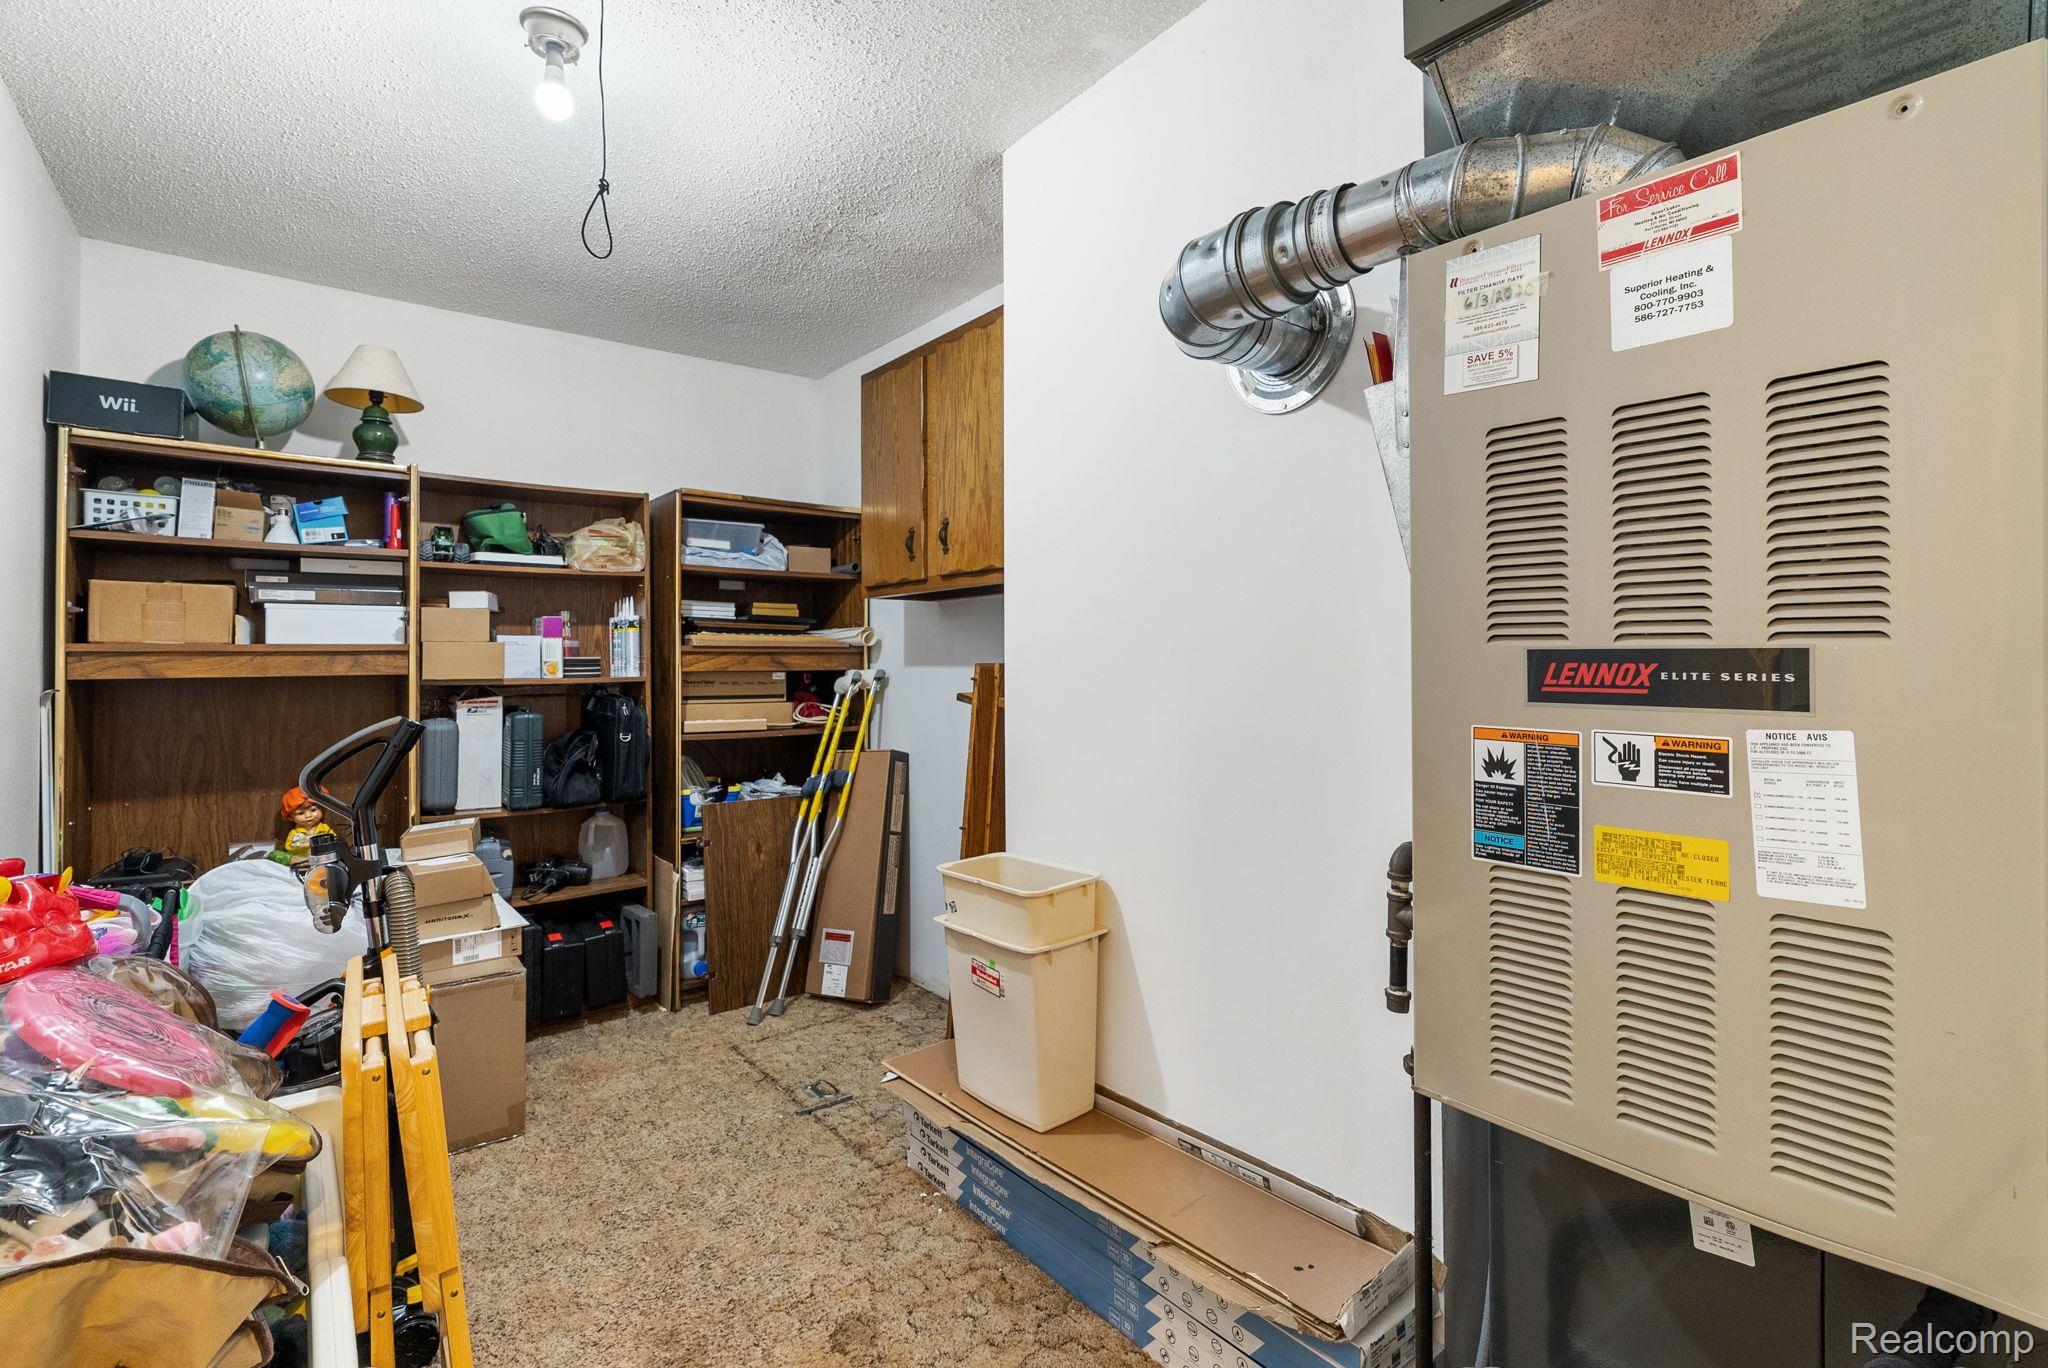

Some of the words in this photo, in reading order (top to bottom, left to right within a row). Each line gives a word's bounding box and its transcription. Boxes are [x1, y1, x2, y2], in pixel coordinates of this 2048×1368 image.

[1601, 196, 1630, 218] For
[1635, 185, 1685, 208] Service
[1690, 162, 1728, 190] Call
[1644, 228, 1692, 249] LENNOX
[1458, 288, 1477, 296] FILTER
[1480, 281, 1505, 290] CHANGE
[1624, 279, 1663, 294] Superior
[1665, 268, 1703, 283] Heating
[1680, 281, 1697, 290] Inc.
[1634, 289, 1704, 312] 800-770-9903
[1634, 300, 1704, 323] 586-727-7753
[1467, 351, 1494, 364] SAVE
[1499, 348, 1513, 358] 5%
[99, 395, 136, 412] Wii
[1544, 662, 1660, 686] LENNOX
[1660, 672, 1711, 681] ELITE
[1720, 672, 1796, 683] SERIES
[1671, 740, 1721, 750] WARNING
[1484, 835, 1514, 845] NOTICE
[1694, 852, 1719, 862] CLOSED
[1706, 878, 1728, 887] FERME
[920, 1118, 943, 1139] Tarkett
[926, 1136, 949, 1157] Tarkett
[927, 1153, 950, 1176] Tarkett
[924, 1167, 947, 1191] Tarkett
